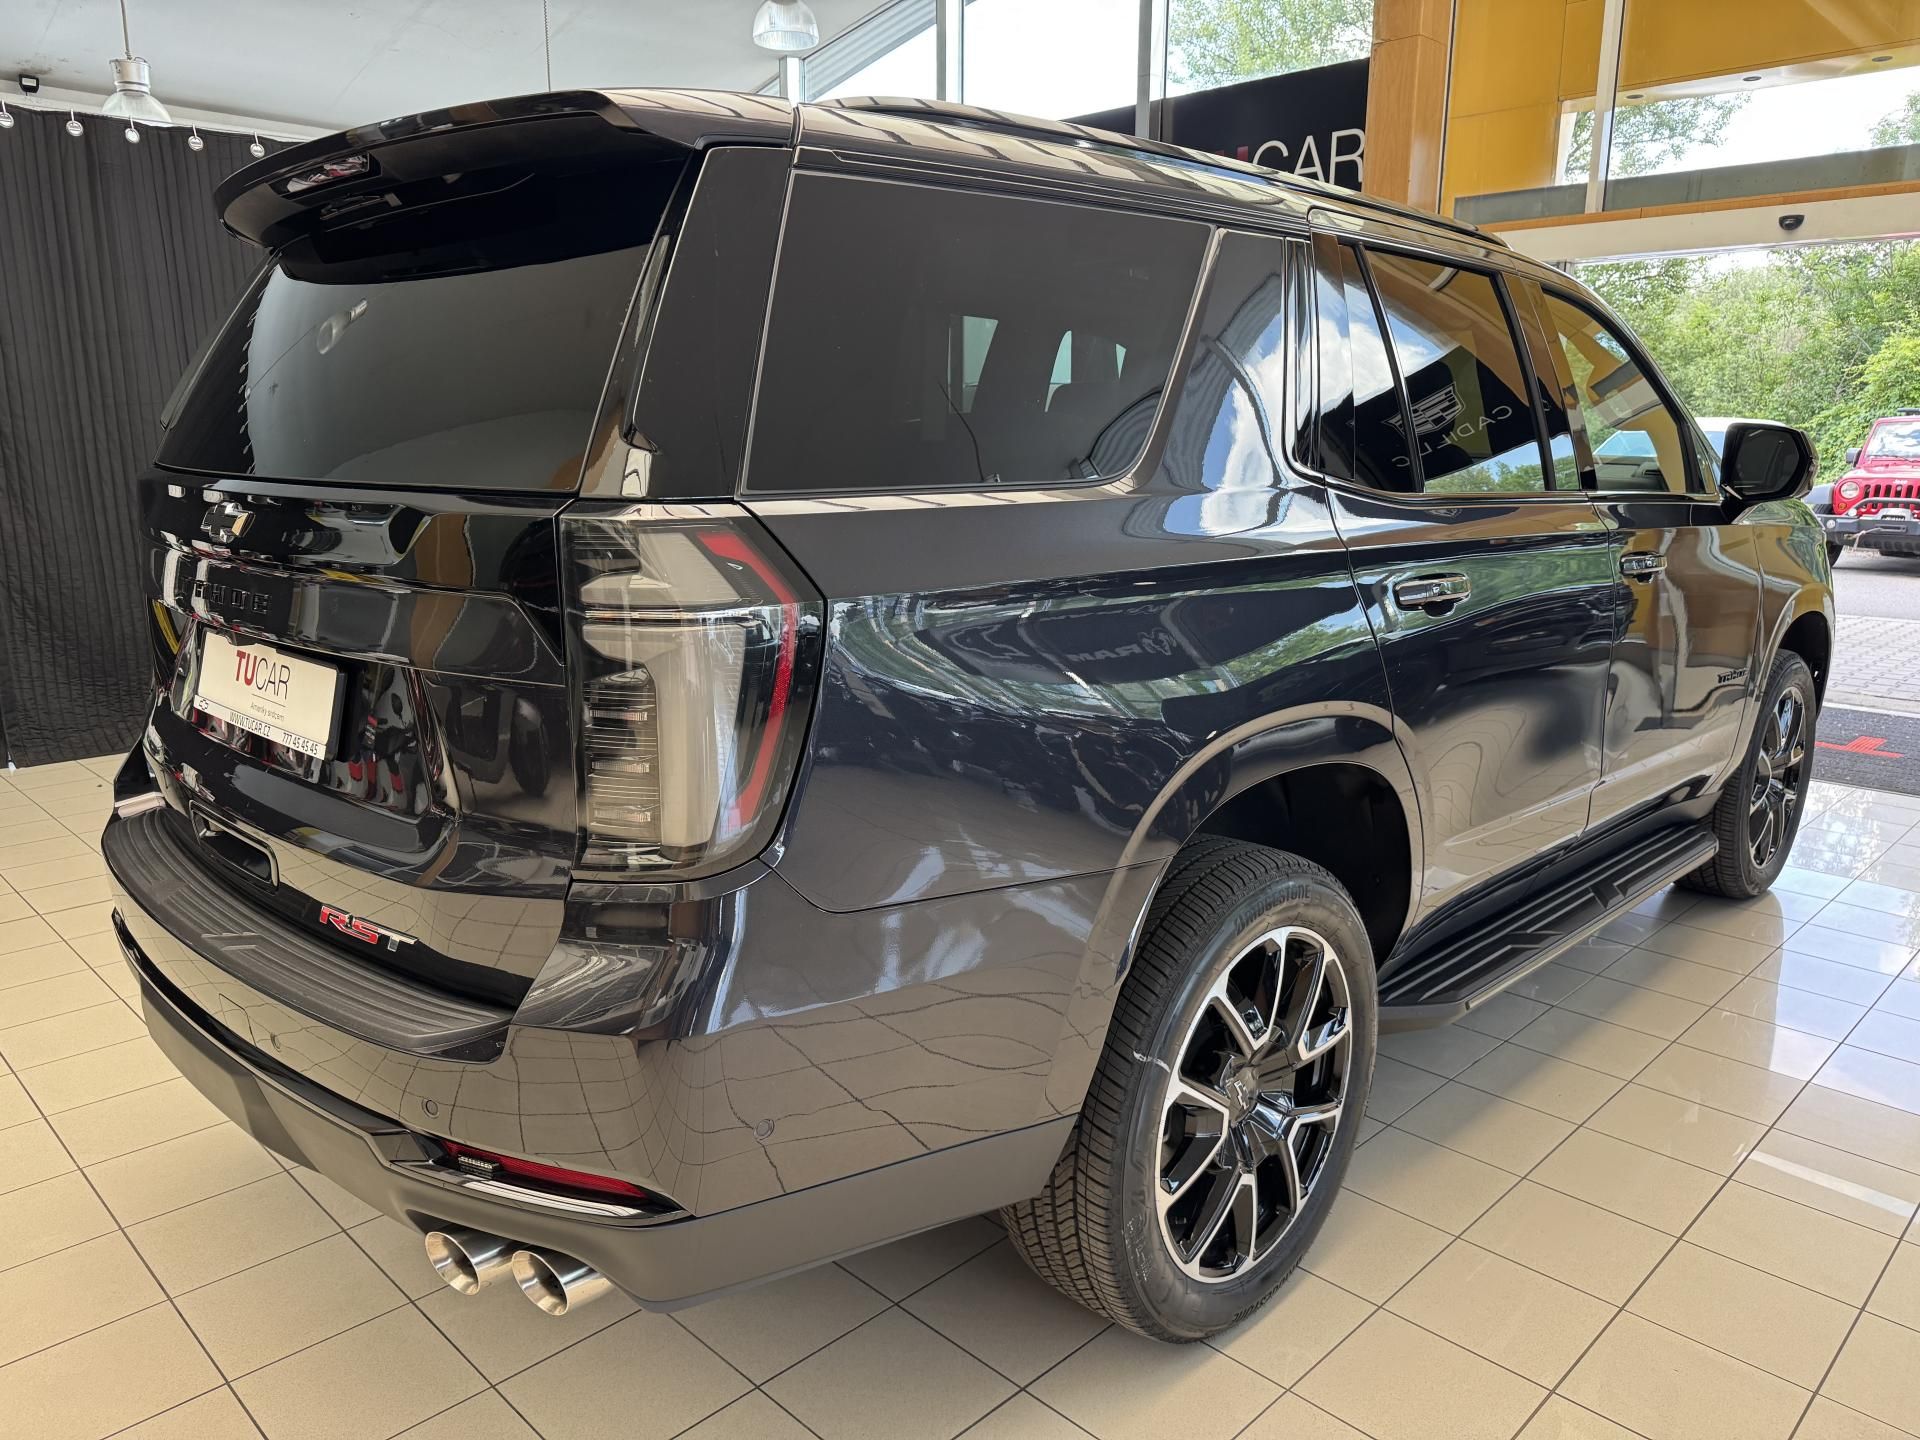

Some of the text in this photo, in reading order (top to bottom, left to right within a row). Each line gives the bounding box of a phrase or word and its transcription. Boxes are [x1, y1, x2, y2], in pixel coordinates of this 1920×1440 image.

[1215, 128, 1366, 185] CAR
[235, 649, 291, 700] TUCAR
[229, 711, 318, 755] WWW.TUCAR.CZ 777 45 45 45
[319, 905, 419, 953] RST
